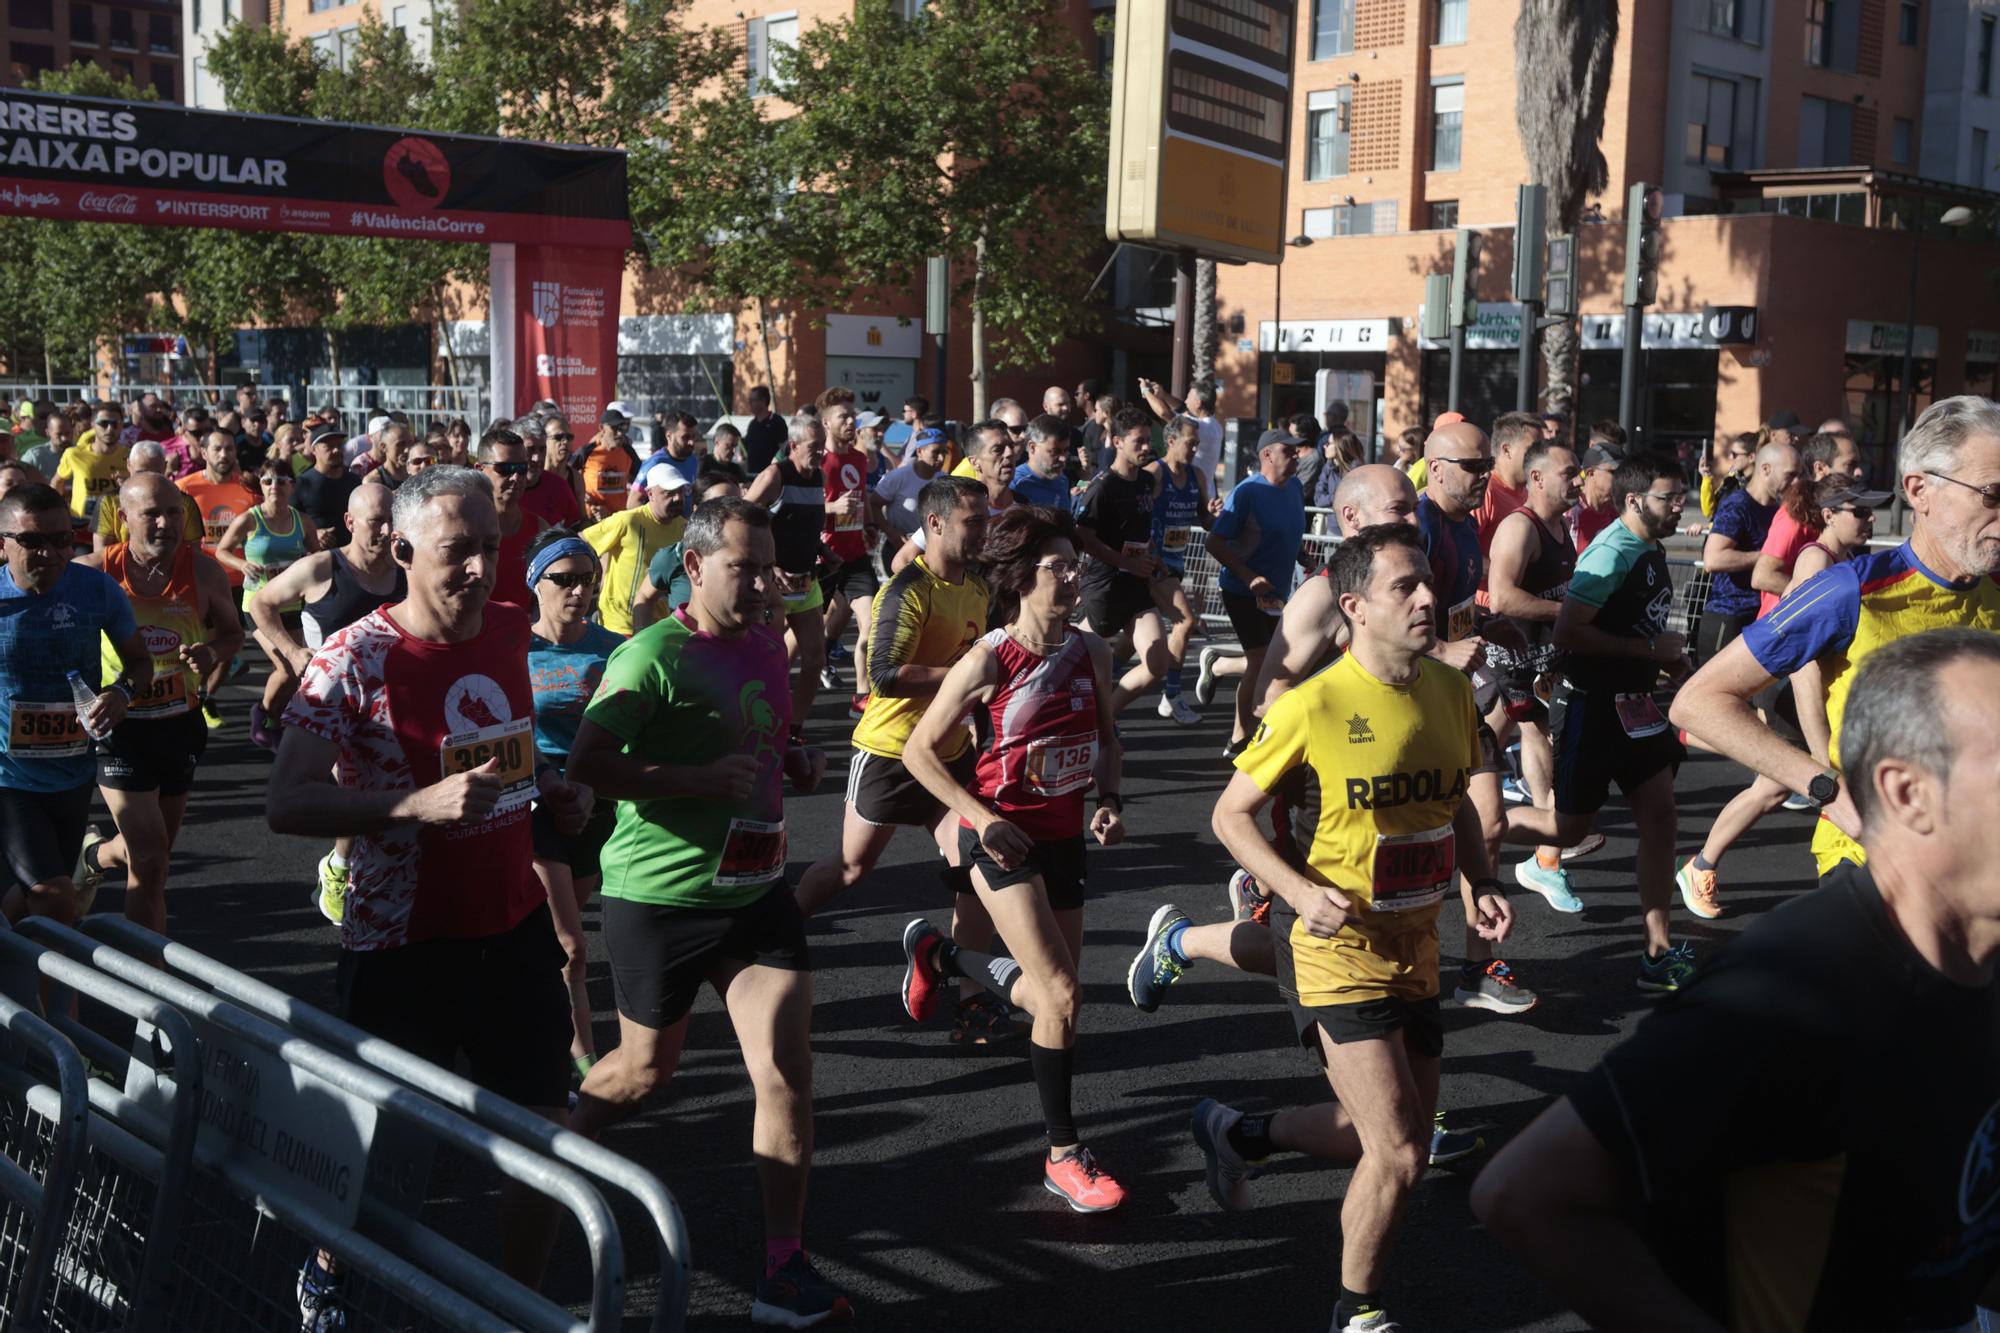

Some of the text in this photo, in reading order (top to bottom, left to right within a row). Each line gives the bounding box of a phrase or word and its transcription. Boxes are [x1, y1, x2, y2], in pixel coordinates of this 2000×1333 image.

[114, 147, 287, 187] POPULAR
[172, 200, 269, 219] INTERSPORT
[291, 210, 331, 219] aspaym
[350, 211, 486, 234] #ValènciaCorre
[562, 286, 604, 296] Fundació
[562, 306, 605, 317] Municipal
[556, 355, 583, 365] caixa
[556, 364, 598, 377] popular
[1348, 733, 1375, 745] luanvi
[1054, 746, 1085, 771] 136
[480, 821, 494, 834] DE
[237, 1109, 268, 1157] DEL
[272, 1129, 352, 1202] RUNNING
